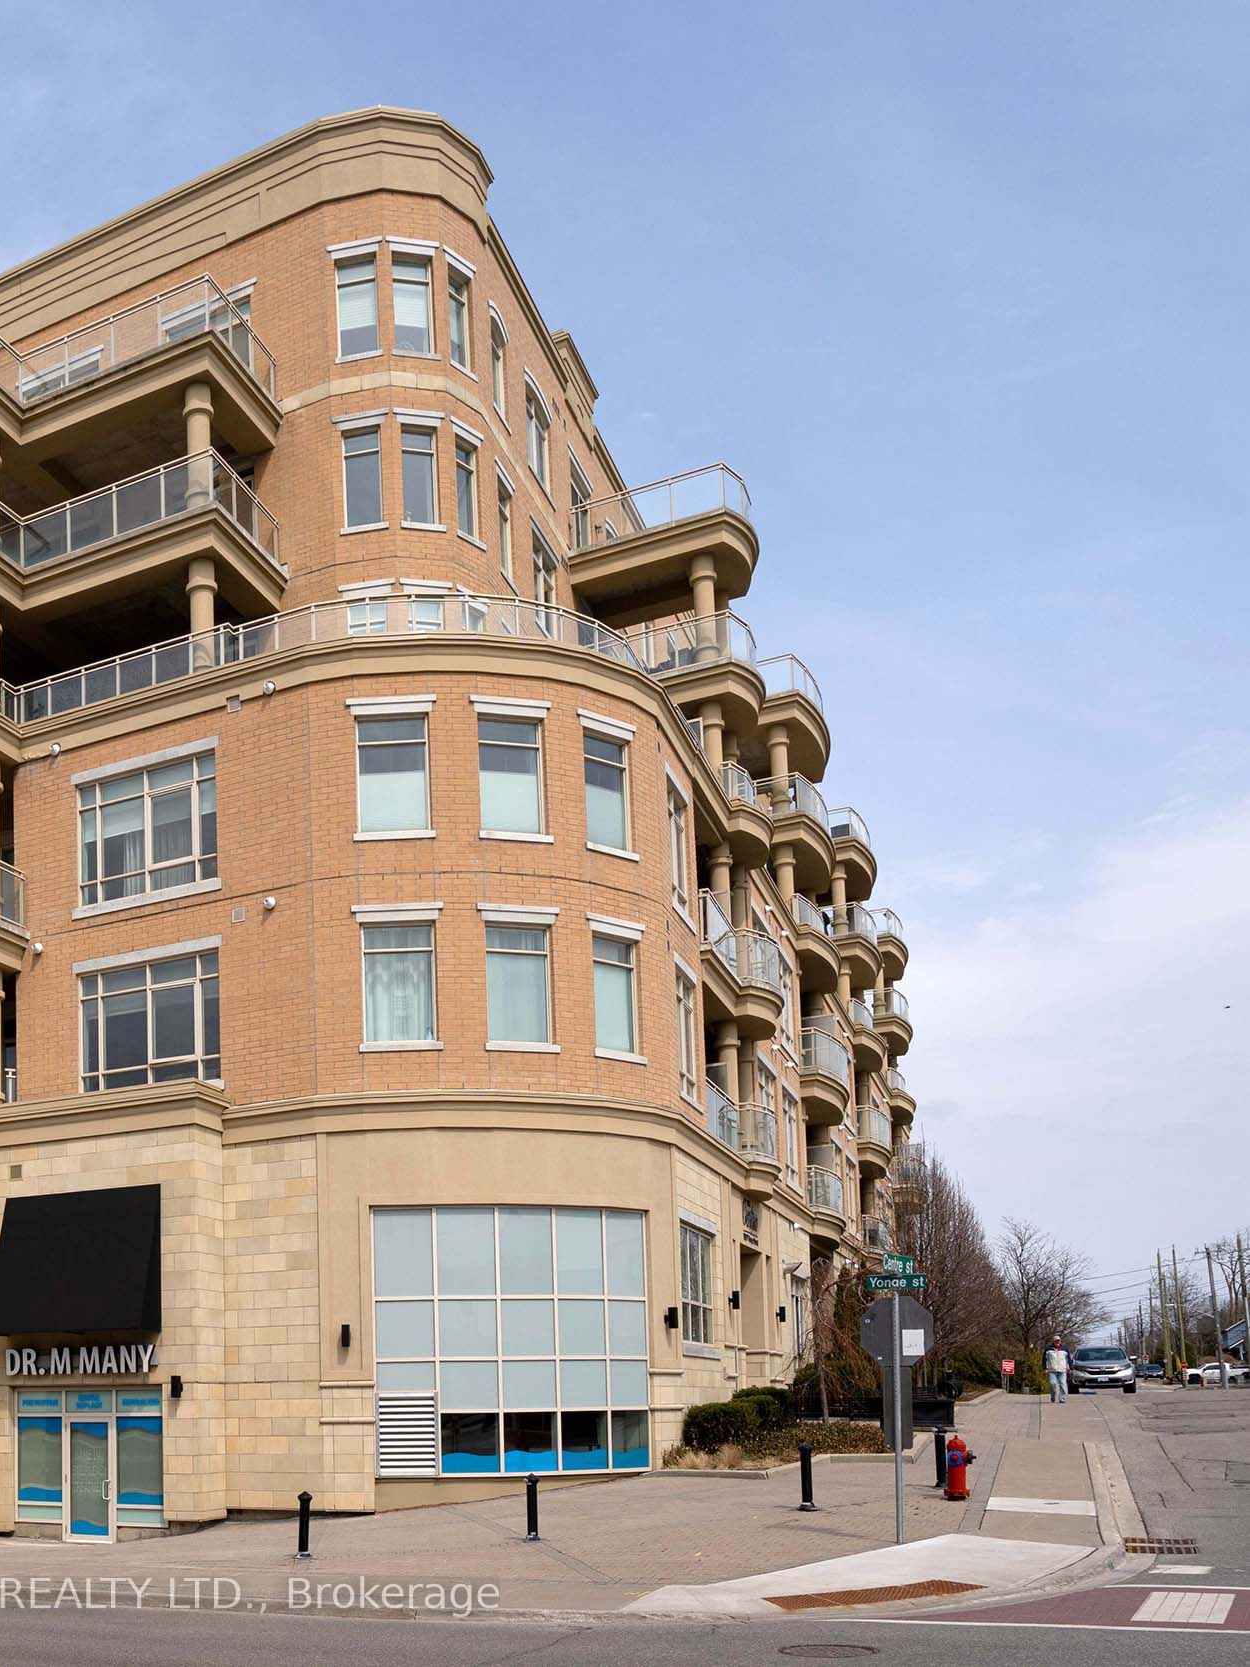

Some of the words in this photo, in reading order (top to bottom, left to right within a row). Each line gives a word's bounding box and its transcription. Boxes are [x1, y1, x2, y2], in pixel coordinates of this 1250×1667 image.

[912, 1276, 924, 1287] st
[5, 1348, 46, 1376] DR.
[50, 1347, 71, 1375] M
[79, 1344, 154, 1374] MANY
